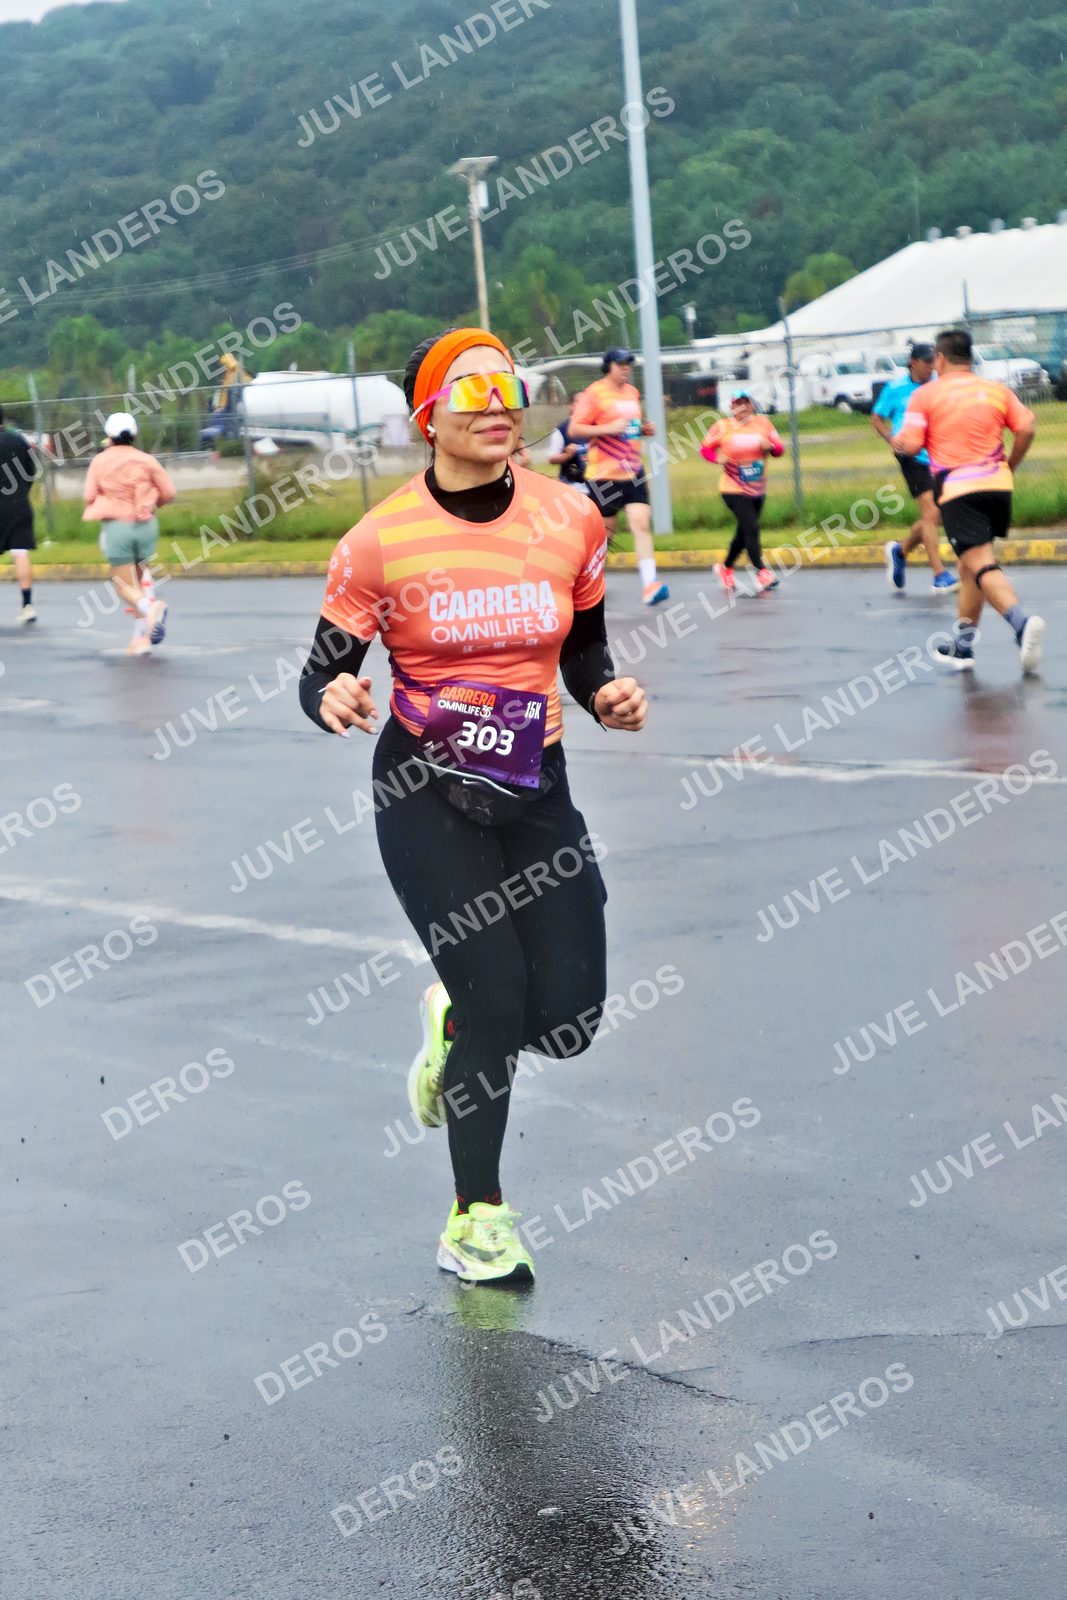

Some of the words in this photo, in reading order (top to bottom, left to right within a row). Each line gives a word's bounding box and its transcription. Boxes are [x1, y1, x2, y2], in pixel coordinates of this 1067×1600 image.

[429, 580, 556, 622] CARRERA
[439, 686, 497, 706] CARRERA
[525, 700, 542, 719] 15K
[457, 721, 515, 756] 303
